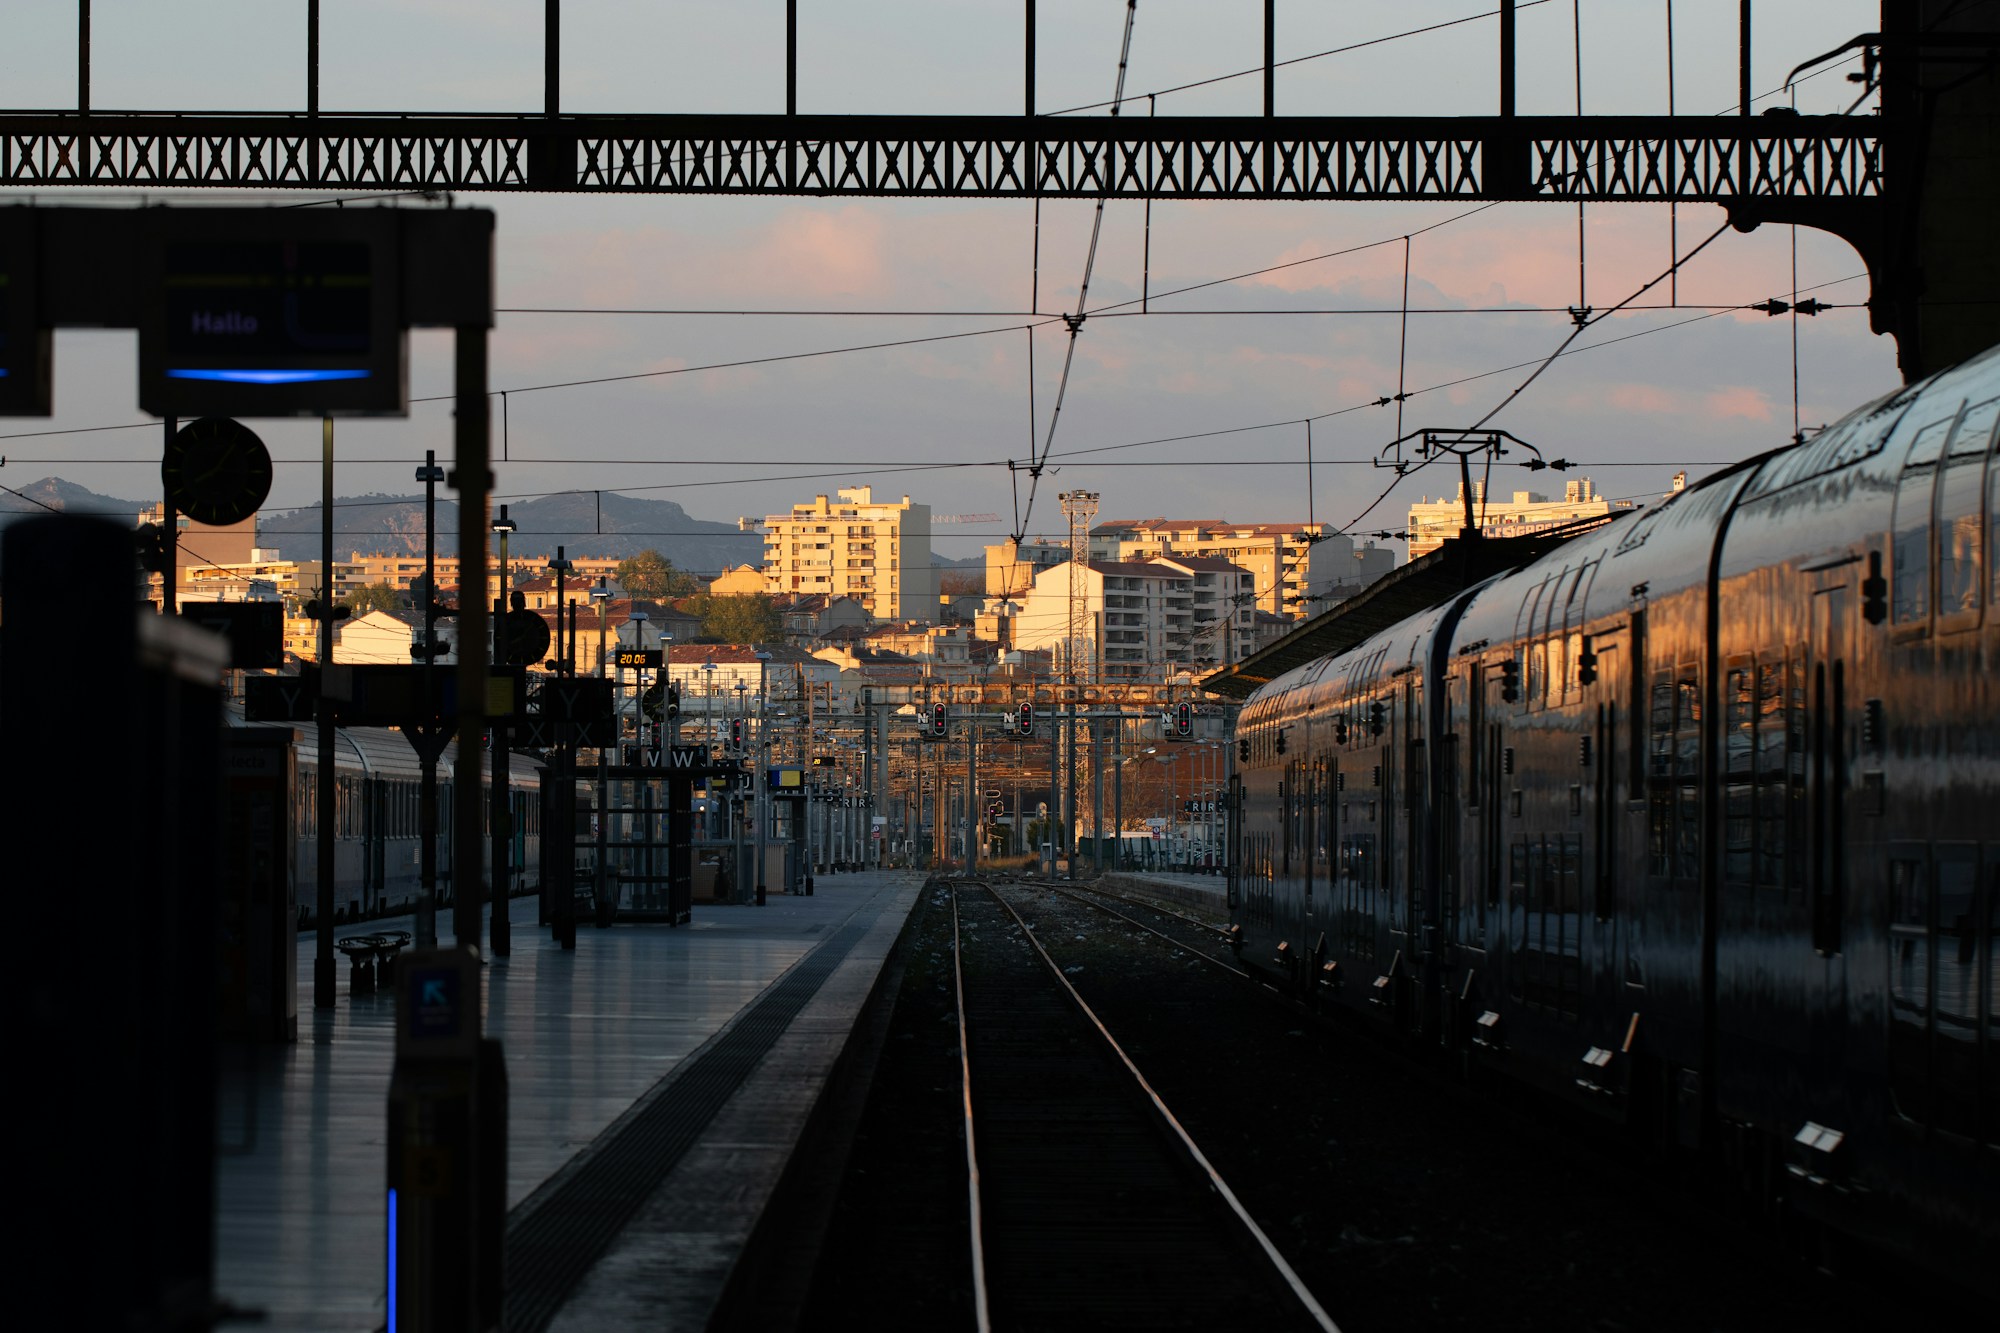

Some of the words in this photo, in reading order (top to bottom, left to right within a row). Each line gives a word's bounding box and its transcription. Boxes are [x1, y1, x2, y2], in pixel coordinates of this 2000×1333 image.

[191, 311, 258, 335] Hallo
[280, 687, 301, 718] Y
[559, 687, 581, 720] Y
[528, 721, 546, 745] X
[576, 721, 593, 745] X
[672, 751, 694, 768] W
